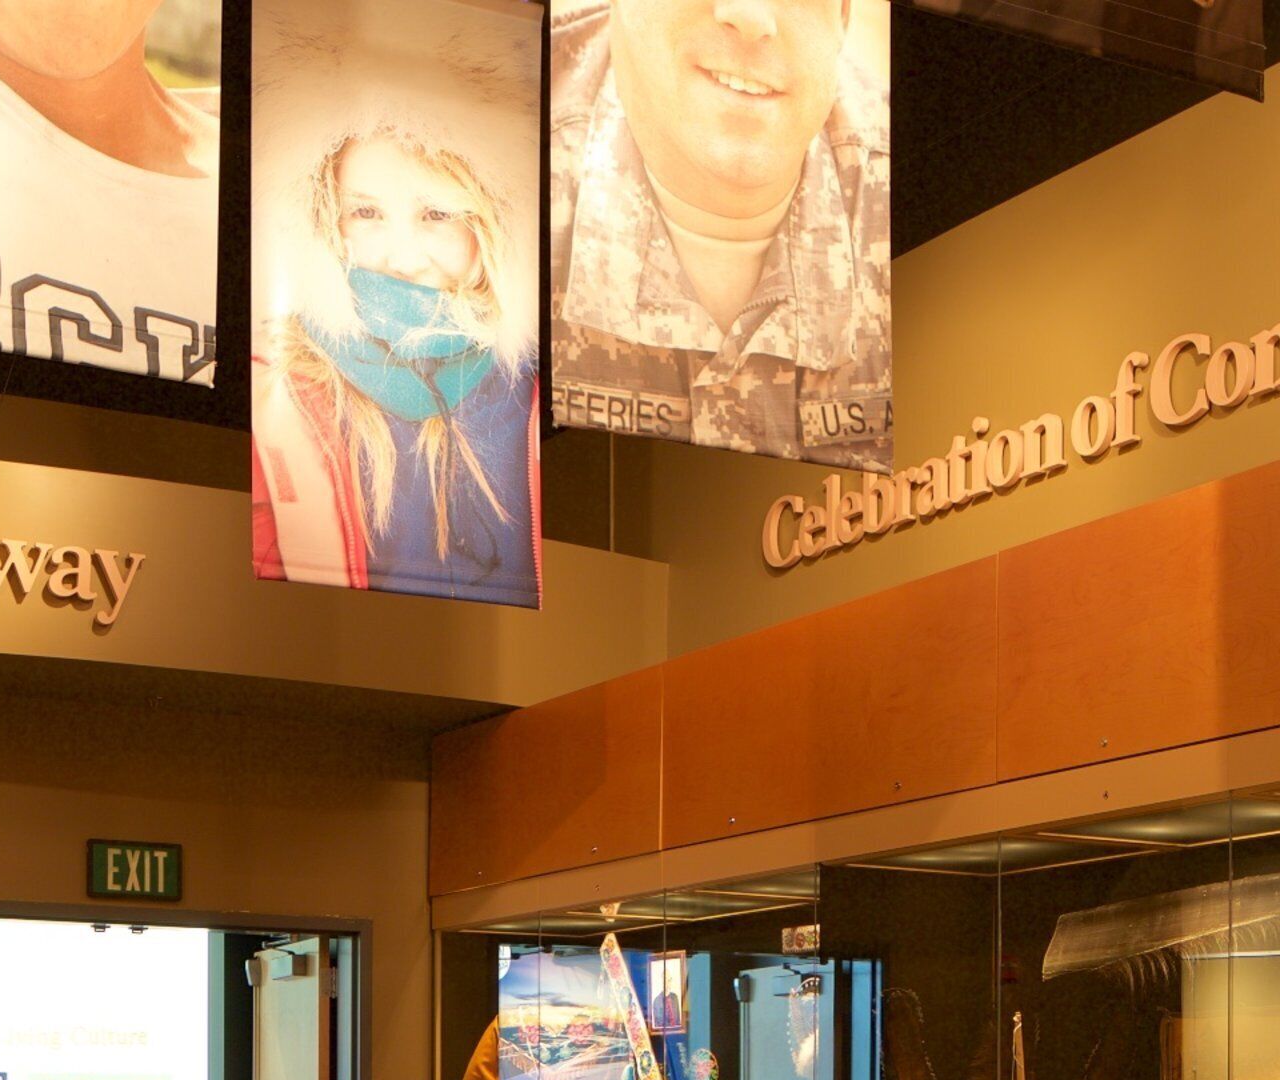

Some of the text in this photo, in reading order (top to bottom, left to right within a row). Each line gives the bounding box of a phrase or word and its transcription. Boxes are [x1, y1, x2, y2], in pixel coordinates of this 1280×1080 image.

[820, 402, 875, 437] U.S.
[761, 412, 1069, 569] Celebration
[1070, 350, 1151, 459] of
[106, 847, 168, 893] EXIT
